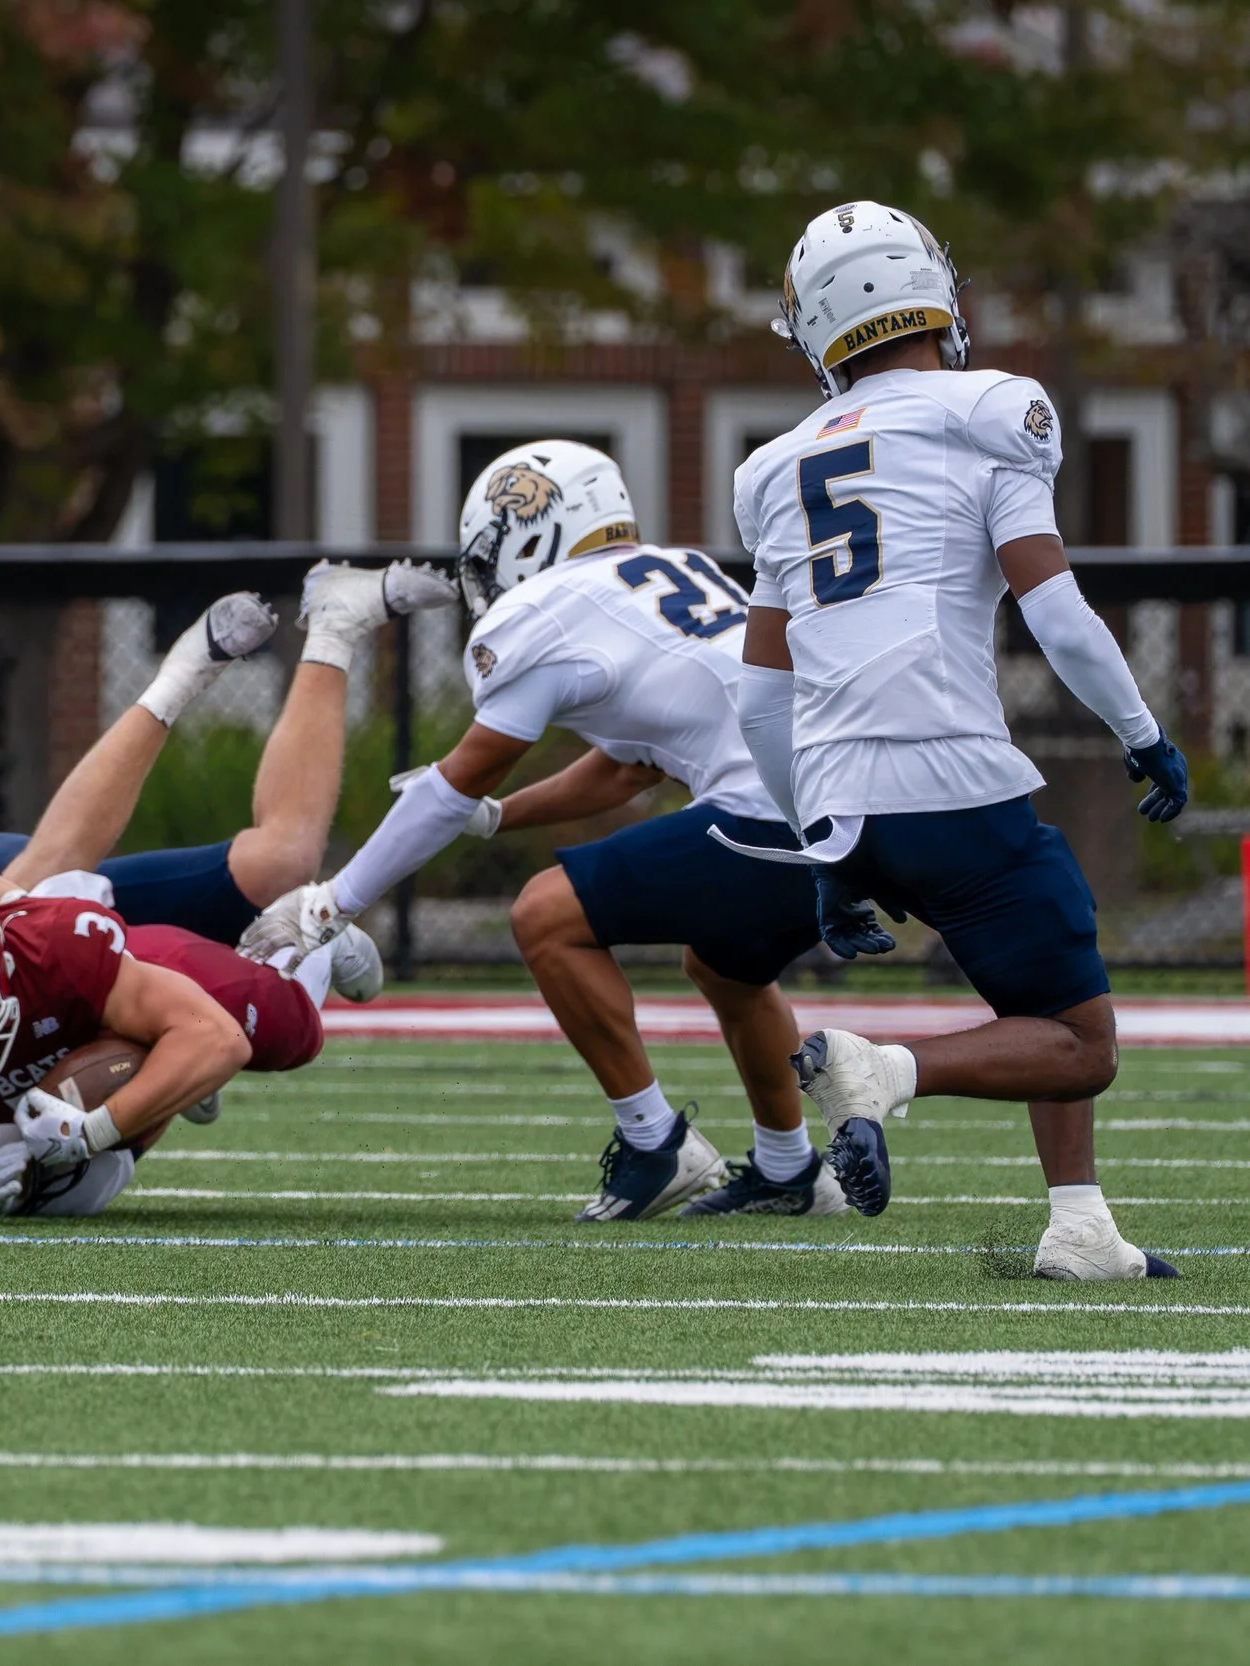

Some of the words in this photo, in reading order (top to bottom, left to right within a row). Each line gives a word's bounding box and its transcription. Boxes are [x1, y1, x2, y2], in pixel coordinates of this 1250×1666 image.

[843, 309, 927, 352] BANTAMS
[796, 435, 884, 609] 5
[613, 551, 750, 645] 21
[73, 911, 126, 955] 3
